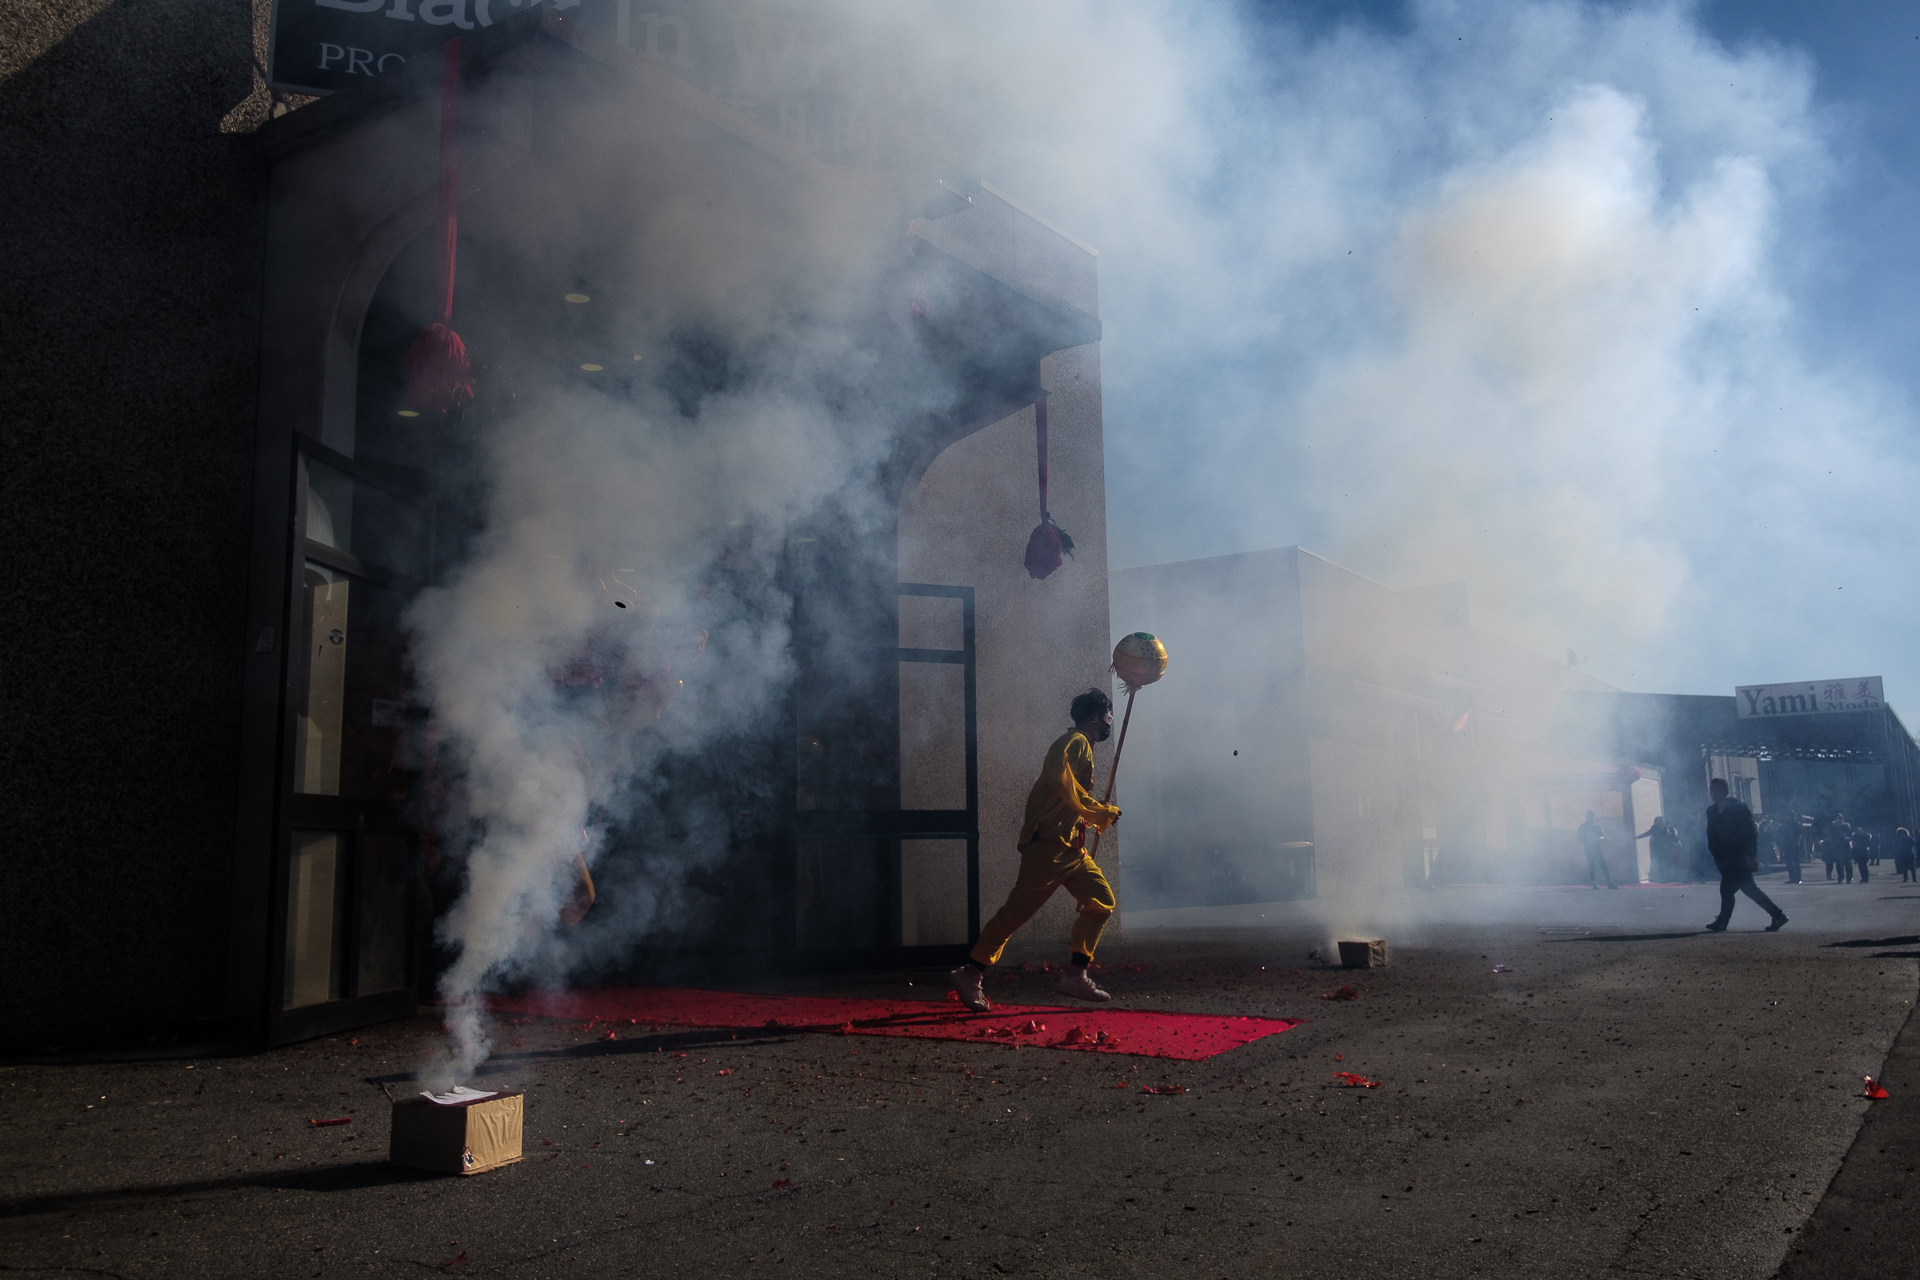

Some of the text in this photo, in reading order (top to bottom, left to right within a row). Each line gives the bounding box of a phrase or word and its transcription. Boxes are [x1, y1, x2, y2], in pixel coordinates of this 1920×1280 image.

[317, 42, 414, 76] PRO
[1741, 686, 1820, 716] Yami
[1827, 700, 1880, 711] Moda
